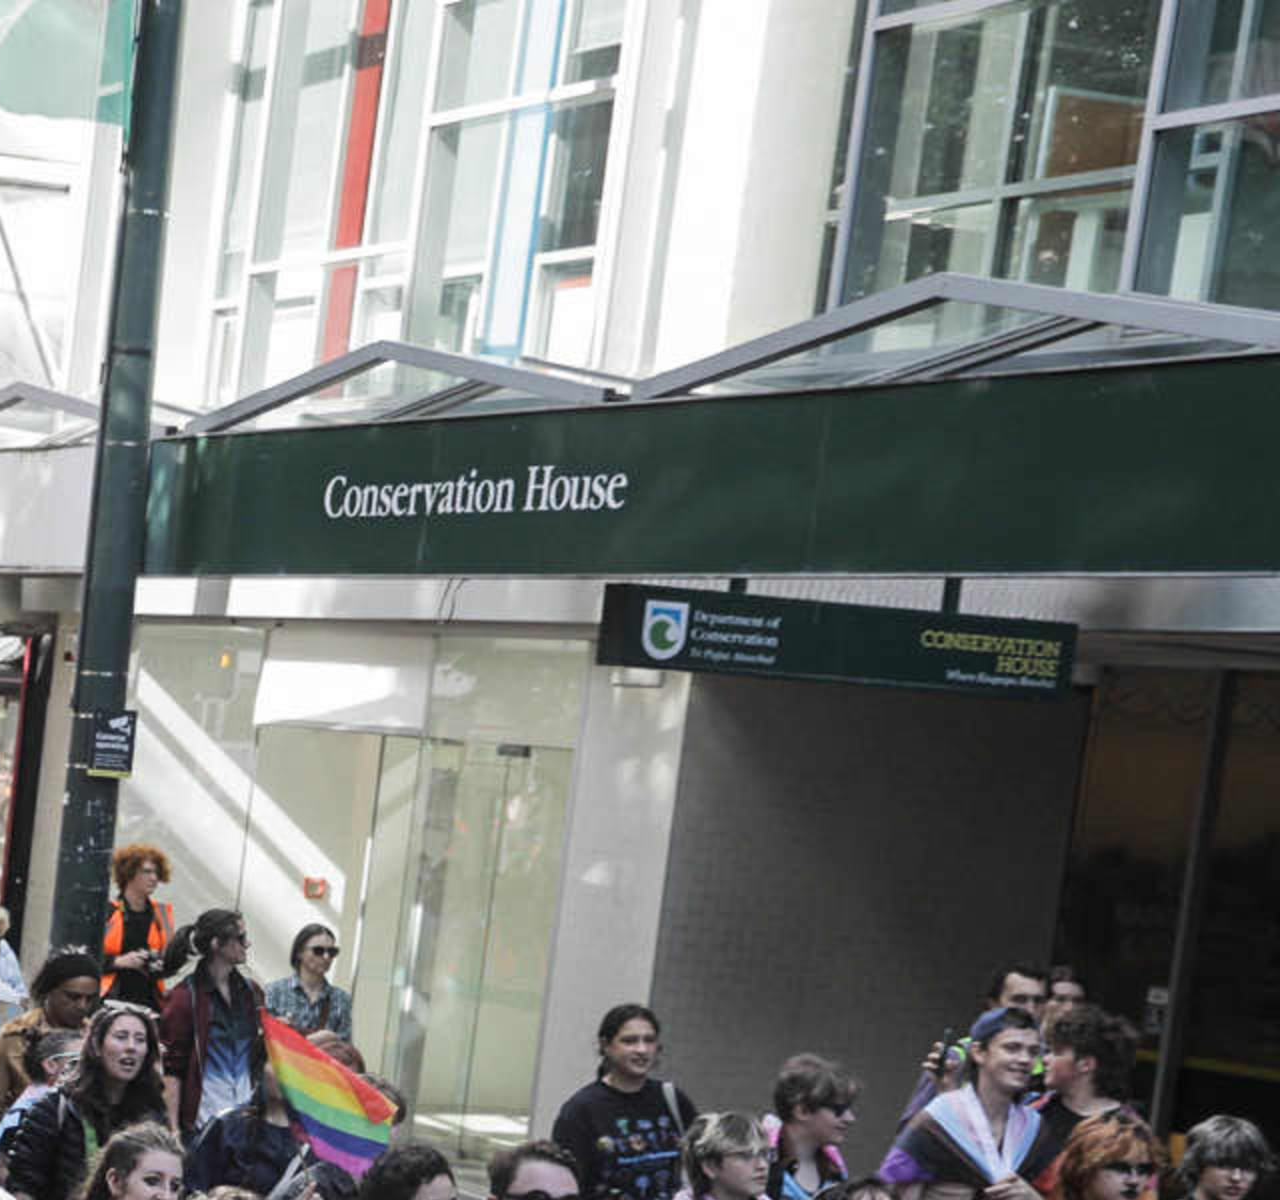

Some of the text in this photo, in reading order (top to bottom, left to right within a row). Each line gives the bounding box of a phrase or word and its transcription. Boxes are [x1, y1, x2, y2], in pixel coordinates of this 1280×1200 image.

[324, 465, 628, 518] Conservation House
[693, 610, 764, 629] Department
[690, 628, 779, 648] Conservation
[920, 629, 1063, 657] CONSERVATION
[996, 655, 1058, 677] HOUSE
